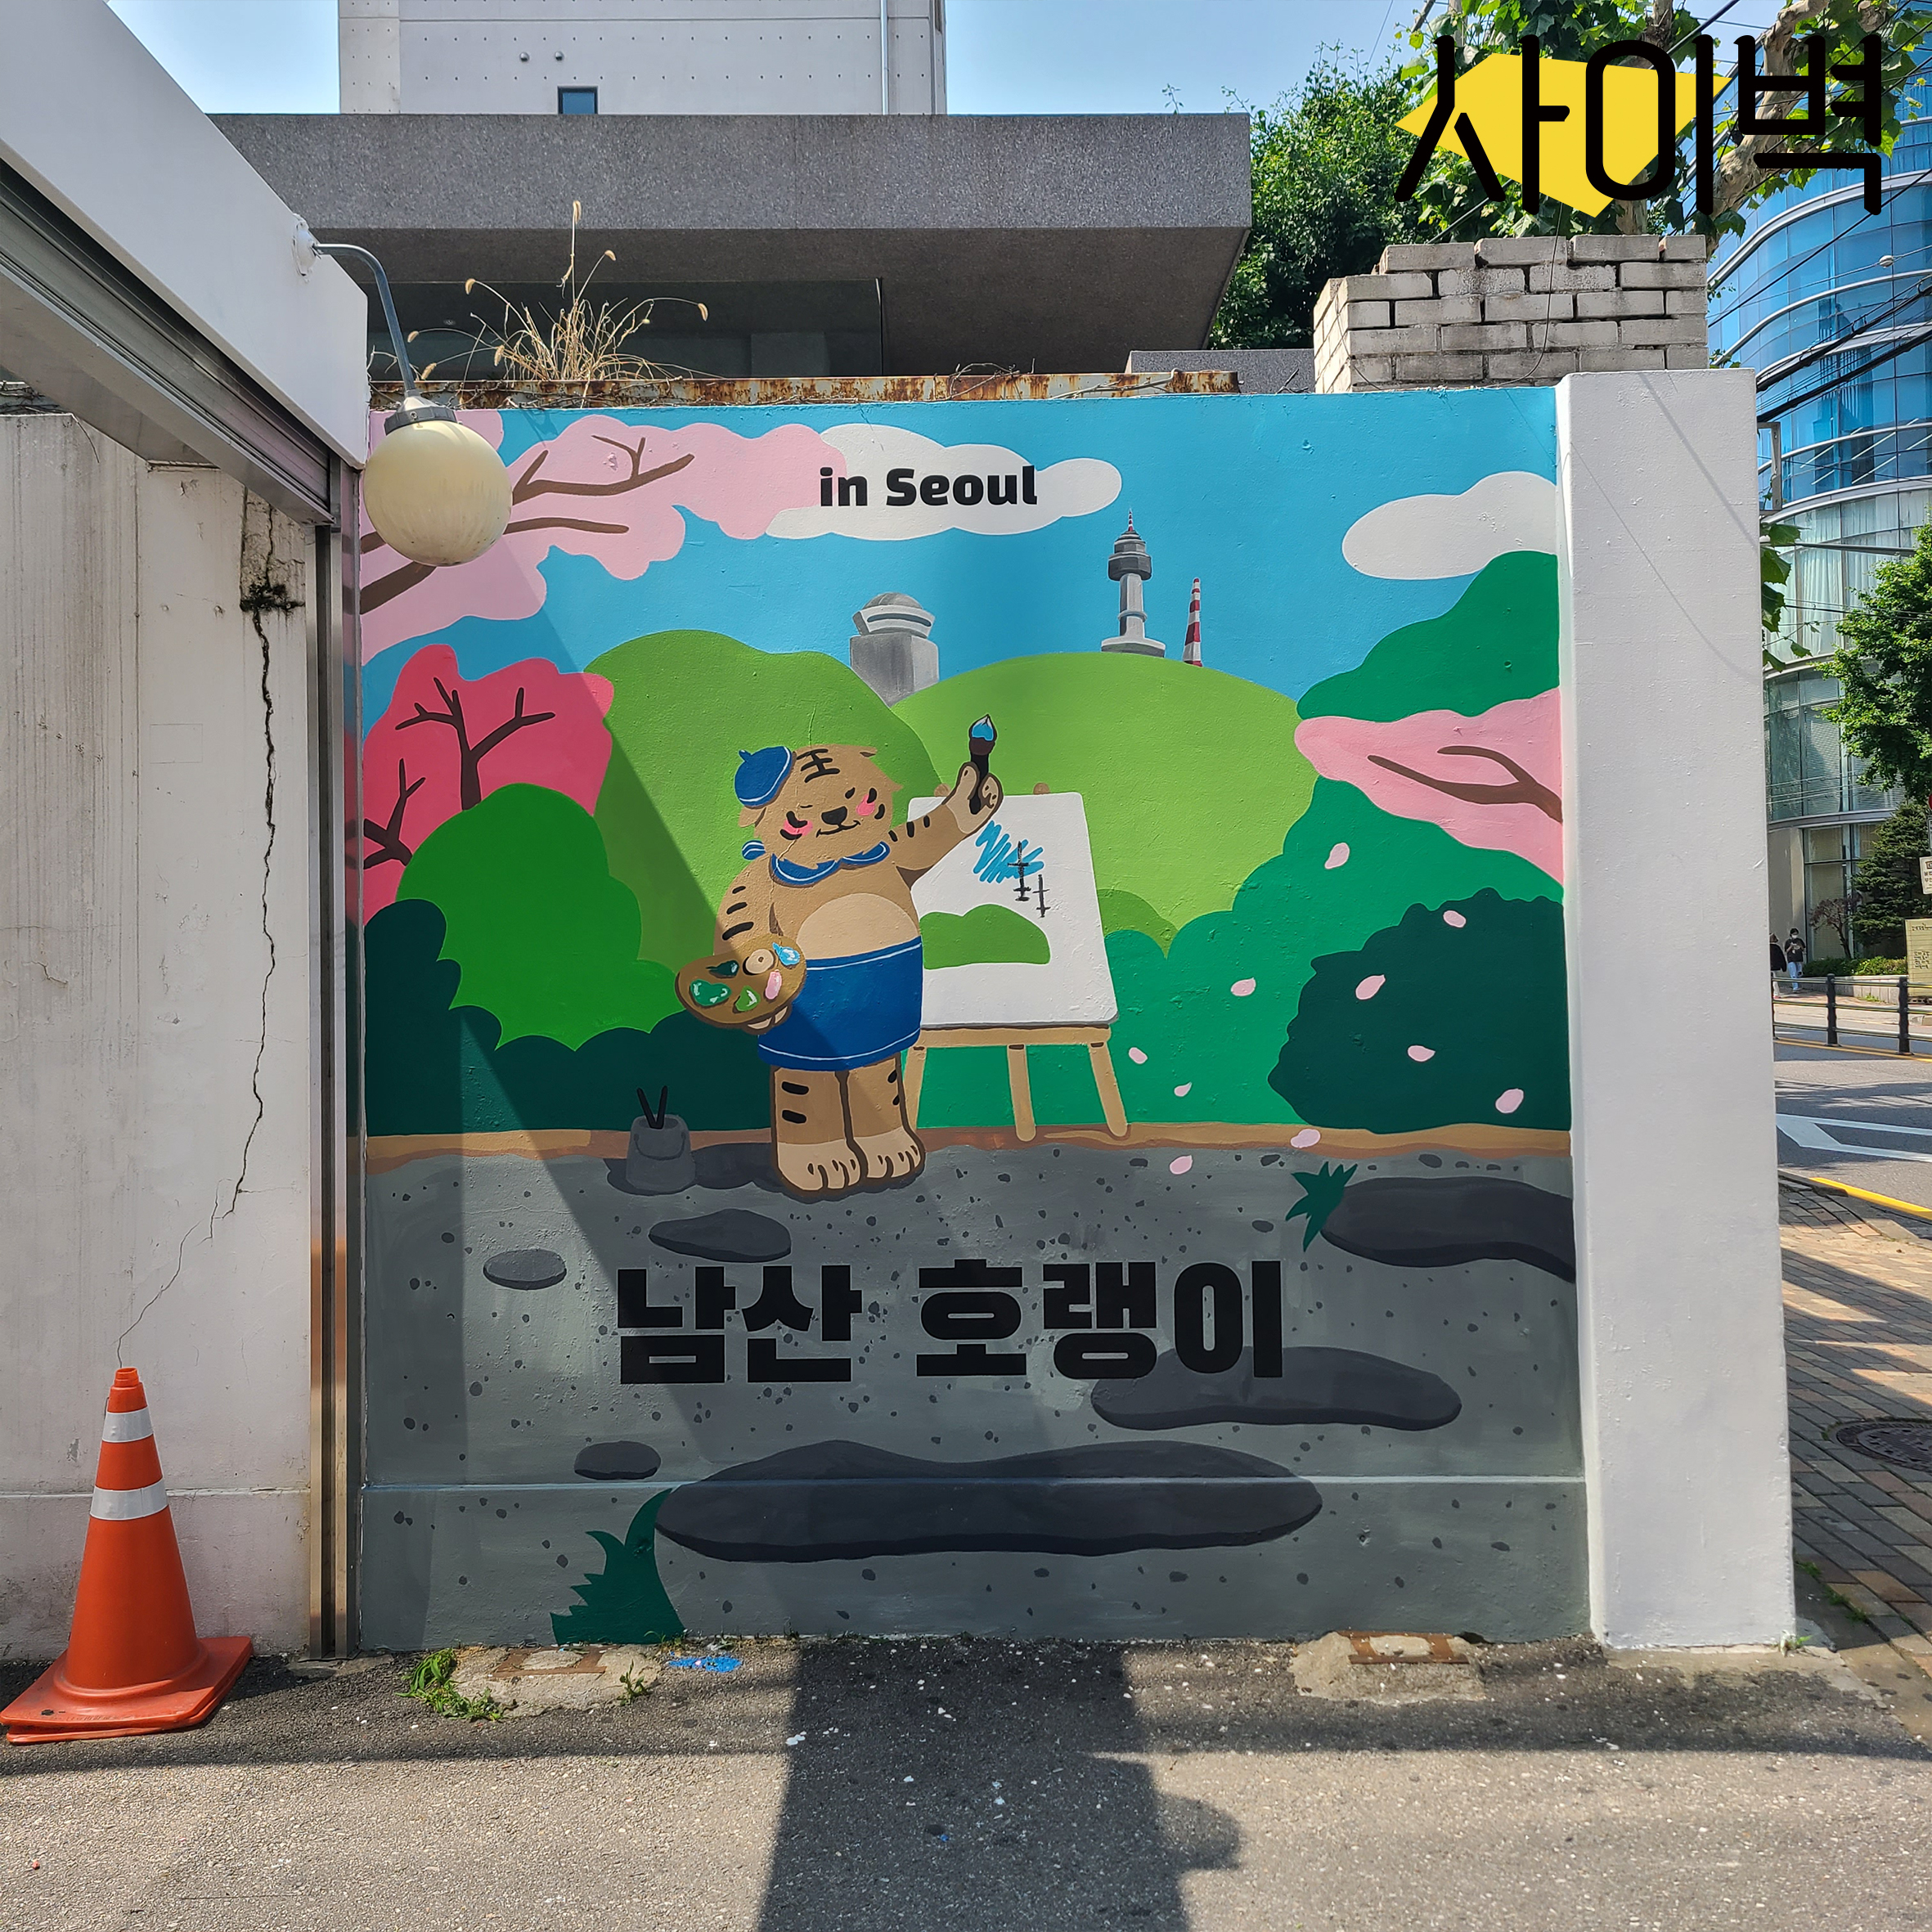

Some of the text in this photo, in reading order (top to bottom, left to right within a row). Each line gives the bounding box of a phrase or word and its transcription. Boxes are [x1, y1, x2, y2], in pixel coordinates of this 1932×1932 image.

[820, 465, 1037, 506] in Seoul
[618, 1259, 1283, 1384] 남산 호랭이
